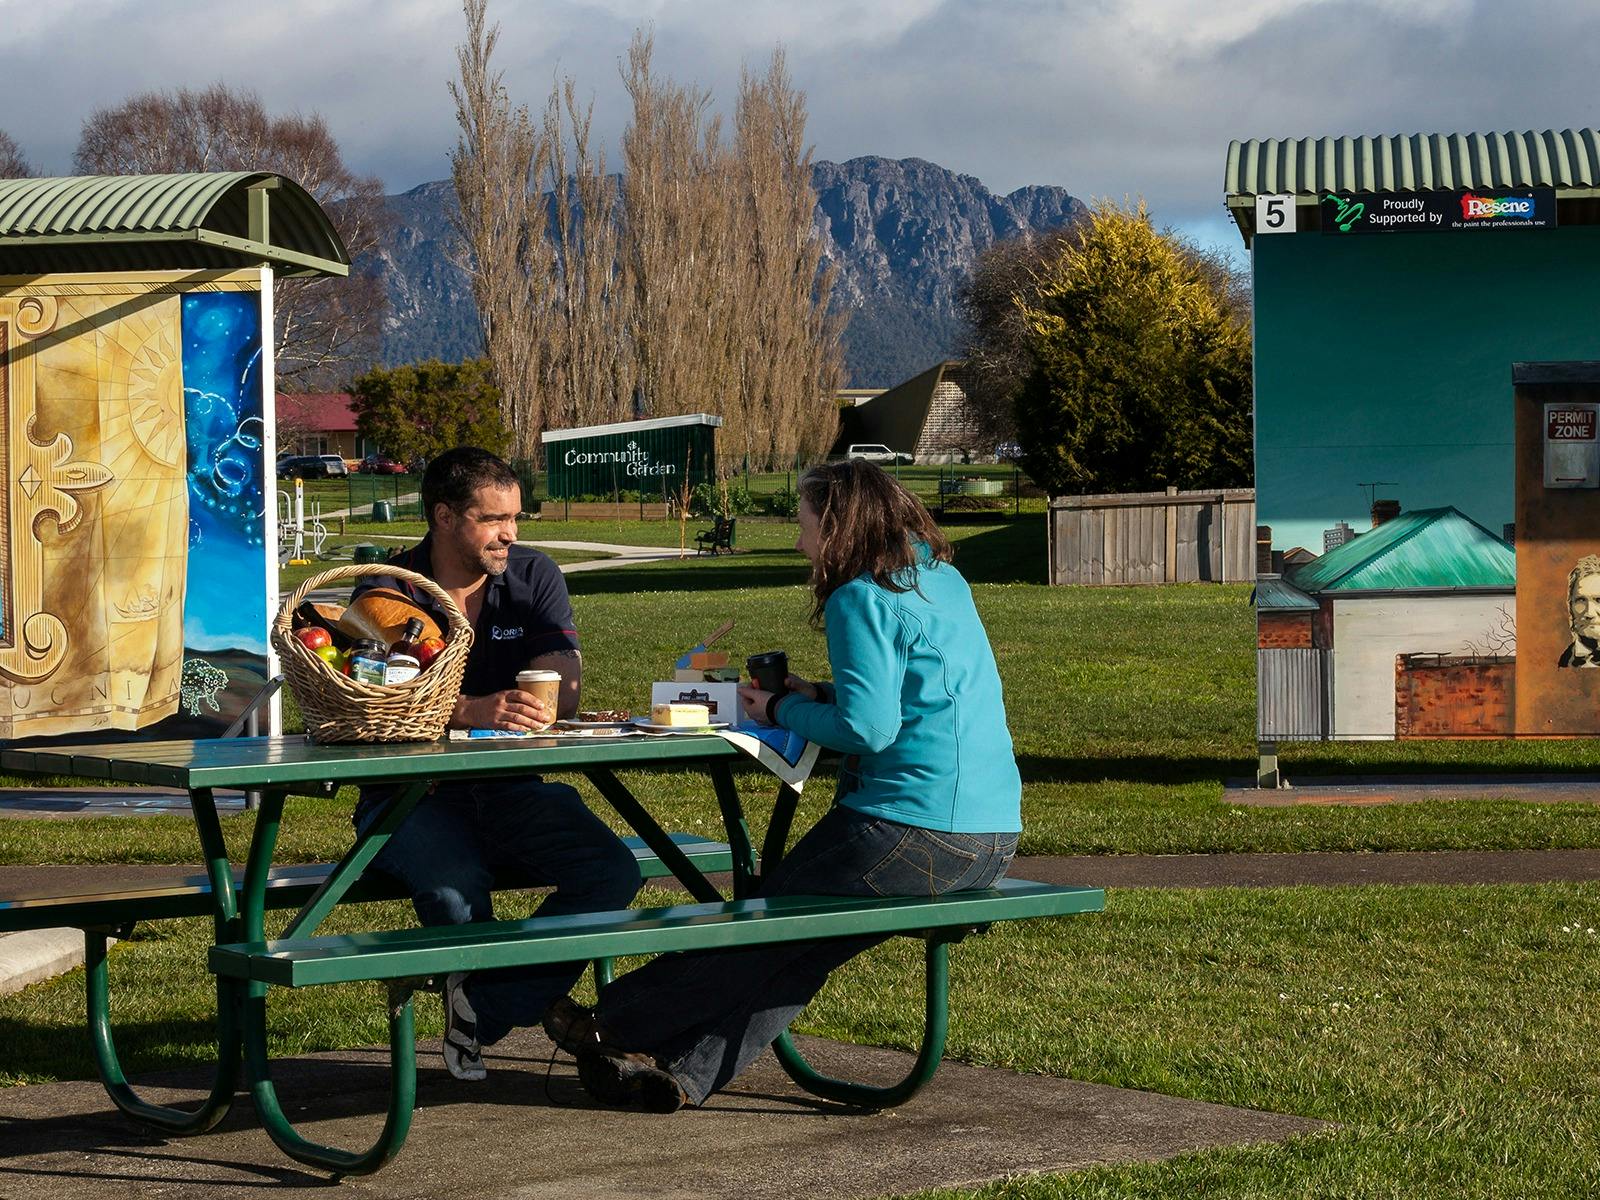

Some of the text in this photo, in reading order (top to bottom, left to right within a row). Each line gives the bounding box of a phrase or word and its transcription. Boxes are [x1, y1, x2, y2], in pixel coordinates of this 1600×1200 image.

[1383, 198, 1425, 212] Proudly
[1467, 200, 1530, 216] Resene
[1265, 199, 1285, 228] 5
[1369, 211, 1443, 226] Supported by
[1463, 221, 1480, 229] paint
[1492, 219, 1534, 228] professionals
[1549, 411, 1594, 424] PERMIT
[1555, 425, 1590, 438] ZONE
[564, 445, 650, 467] Community
[626, 460, 677, 478] Garden
